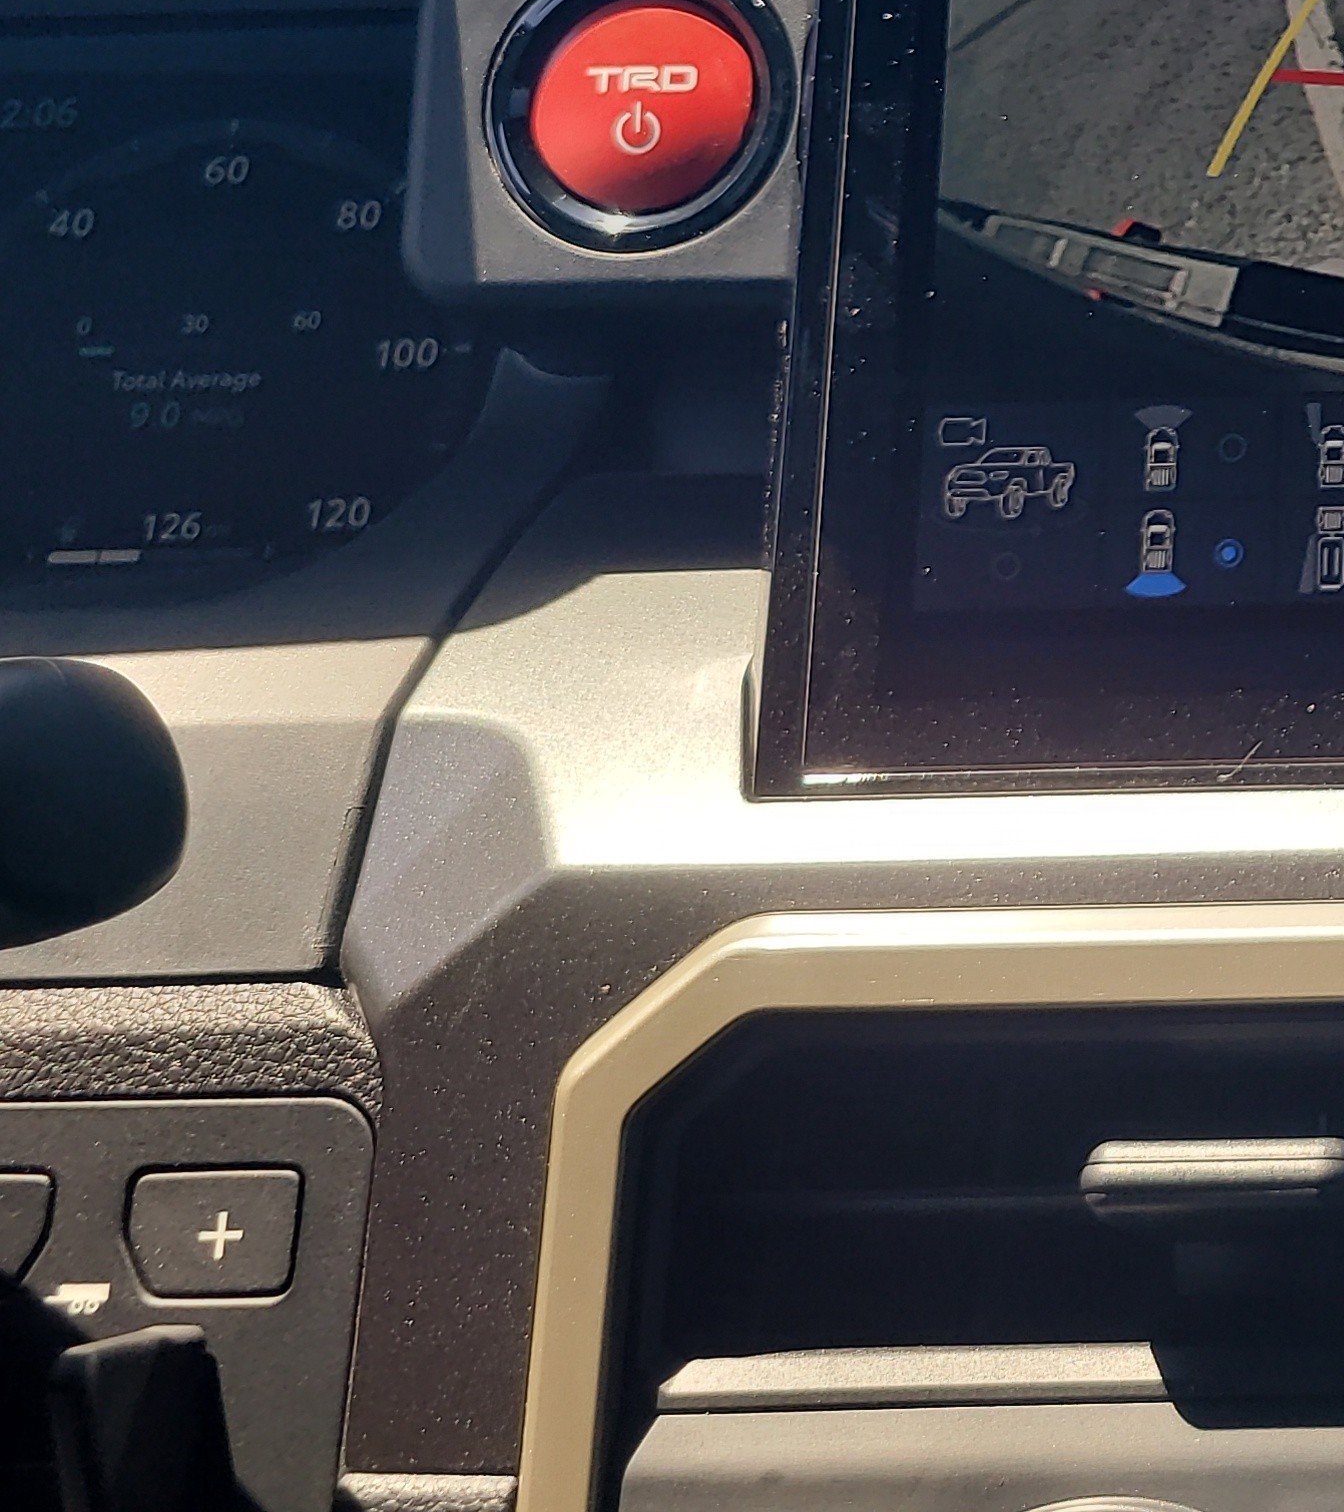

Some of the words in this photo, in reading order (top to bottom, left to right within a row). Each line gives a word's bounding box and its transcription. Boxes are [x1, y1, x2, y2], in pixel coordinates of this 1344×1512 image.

[586, 64, 699, 94] TRD
[204, 155, 250, 185] 60
[47, 207, 96, 238] 40
[336, 199, 383, 231] 80
[376, 337, 440, 369] 100
[112, 369, 166, 392] Total
[171, 368, 262, 394] Average
[143, 511, 202, 542] 126
[306, 496, 372, 531] 120
